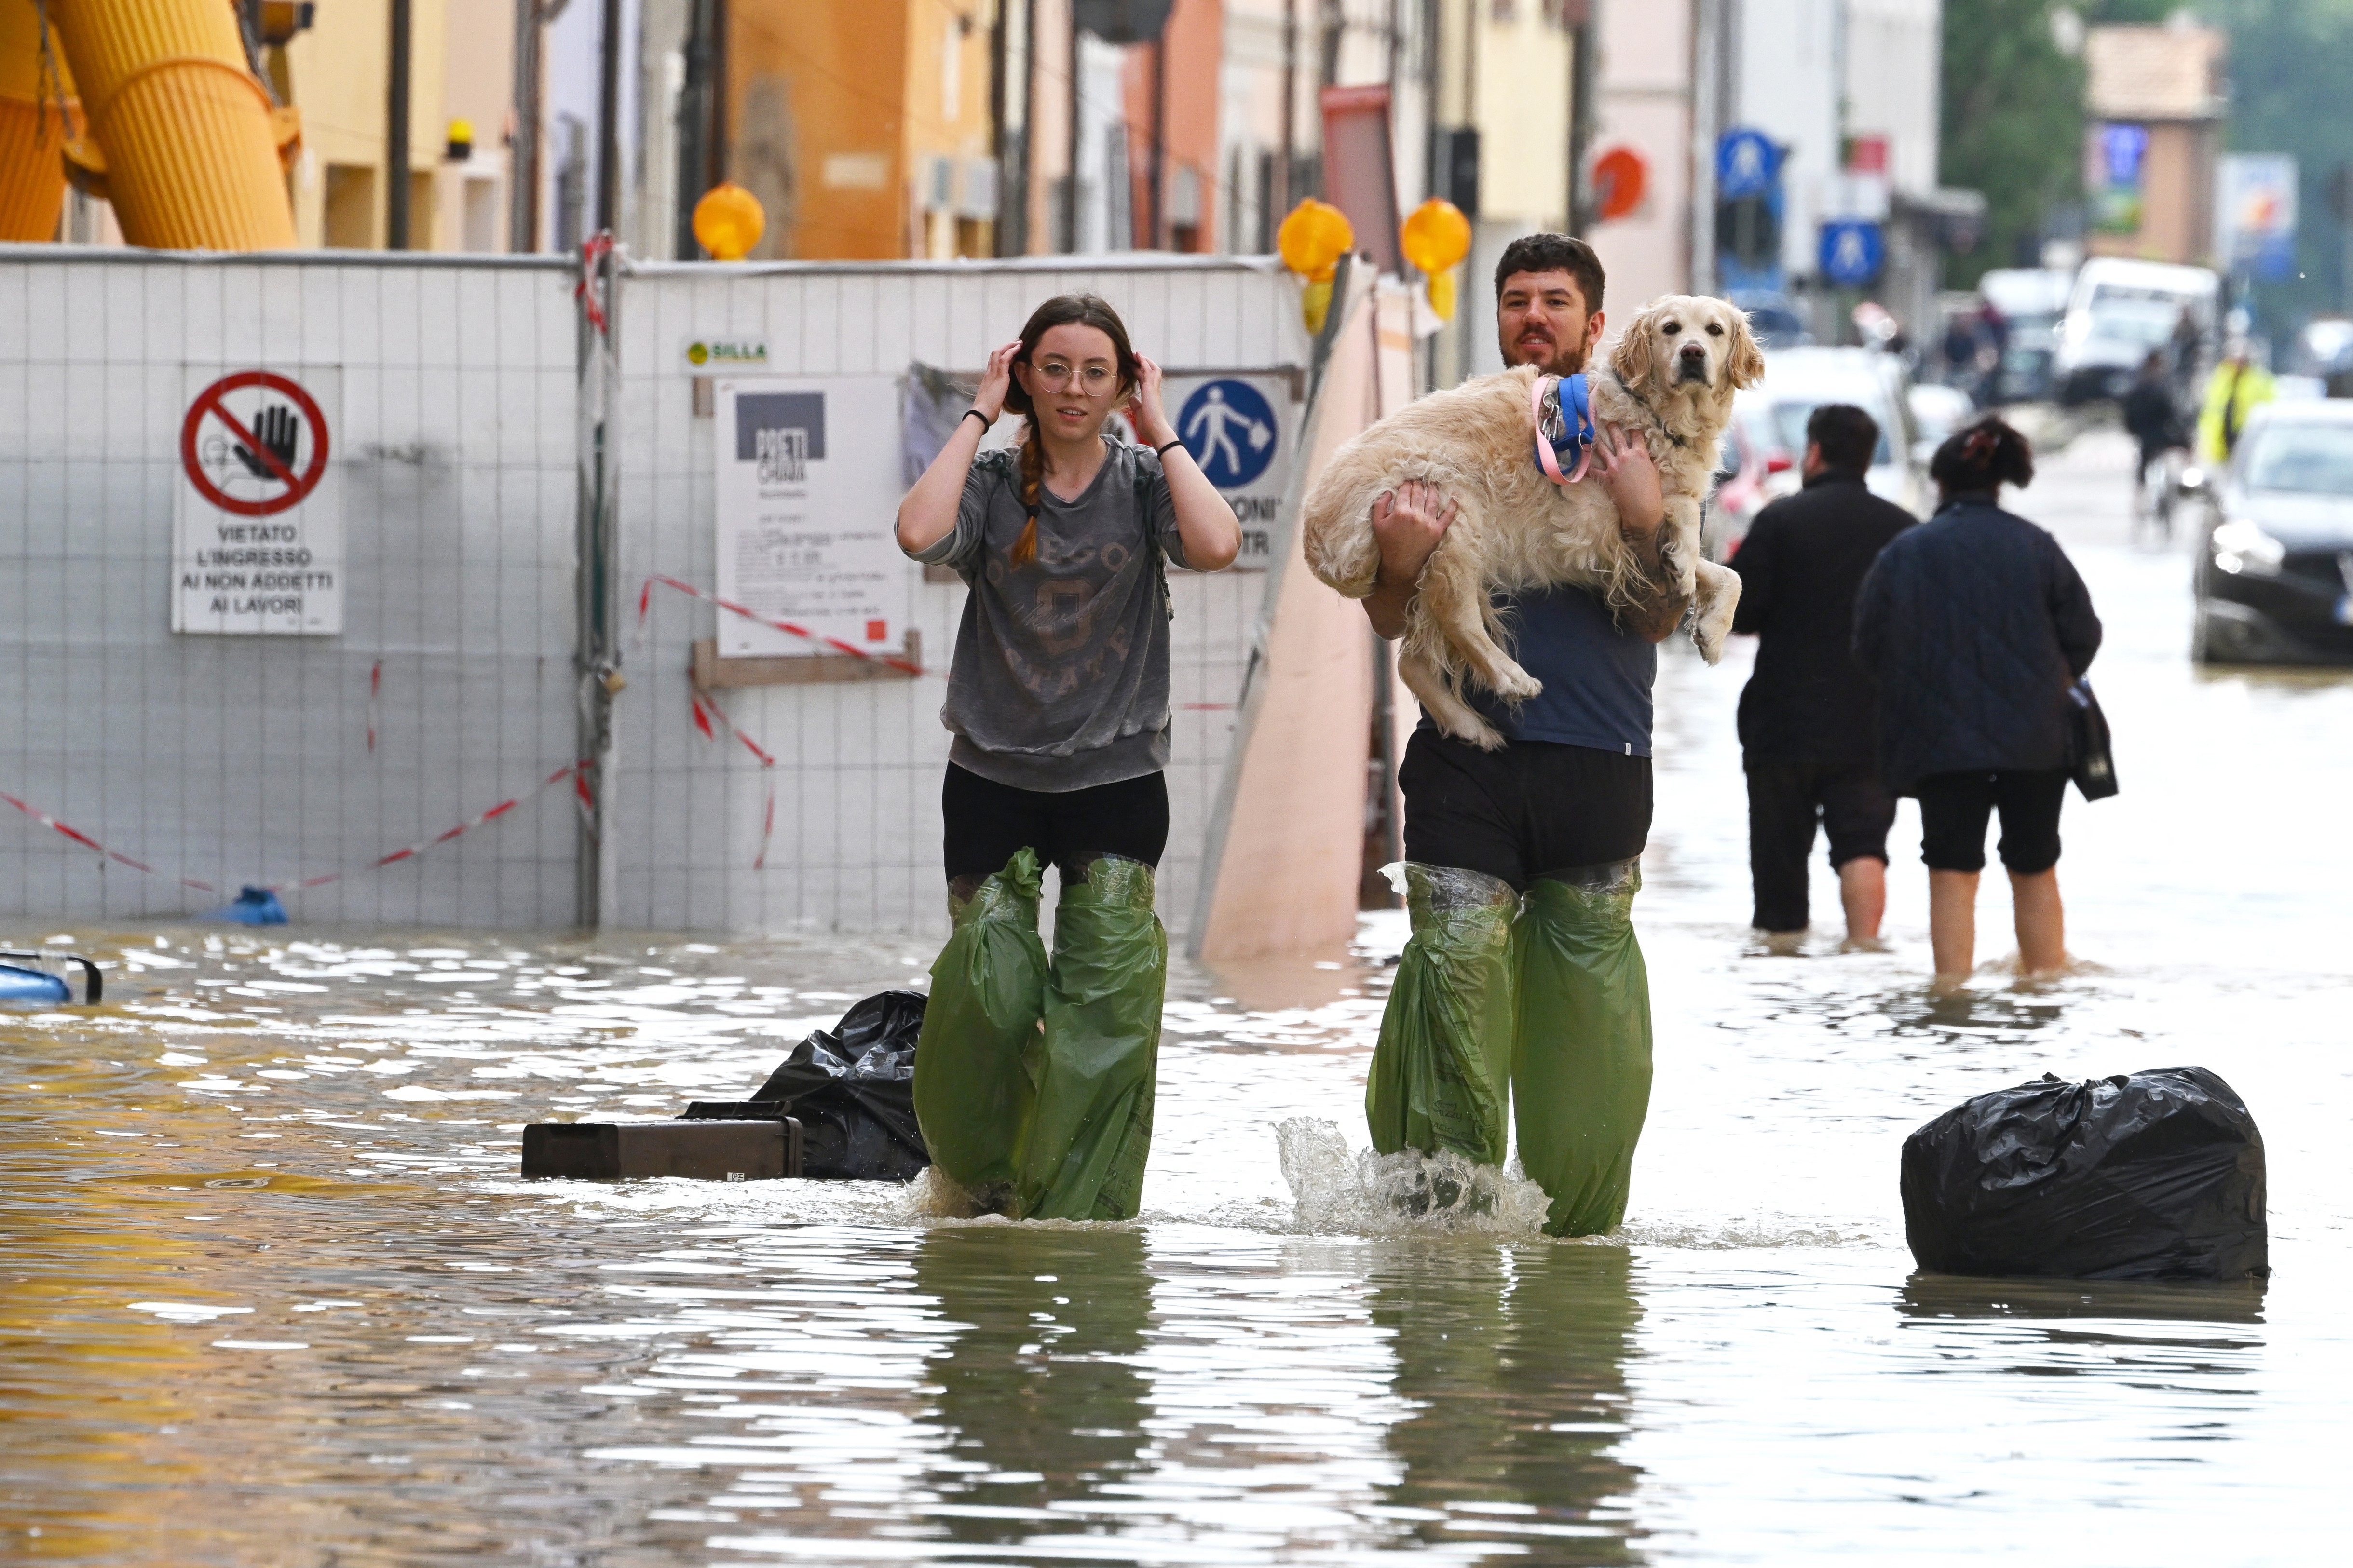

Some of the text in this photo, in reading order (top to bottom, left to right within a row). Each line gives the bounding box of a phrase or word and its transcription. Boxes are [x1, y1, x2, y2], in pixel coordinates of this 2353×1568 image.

[218, 525, 296, 543] VIETATO
[197, 548, 312, 567] L'INGRESSO
[182, 572, 333, 590] AI NON ADDETTI
[210, 596, 302, 615] AI LAVORI
